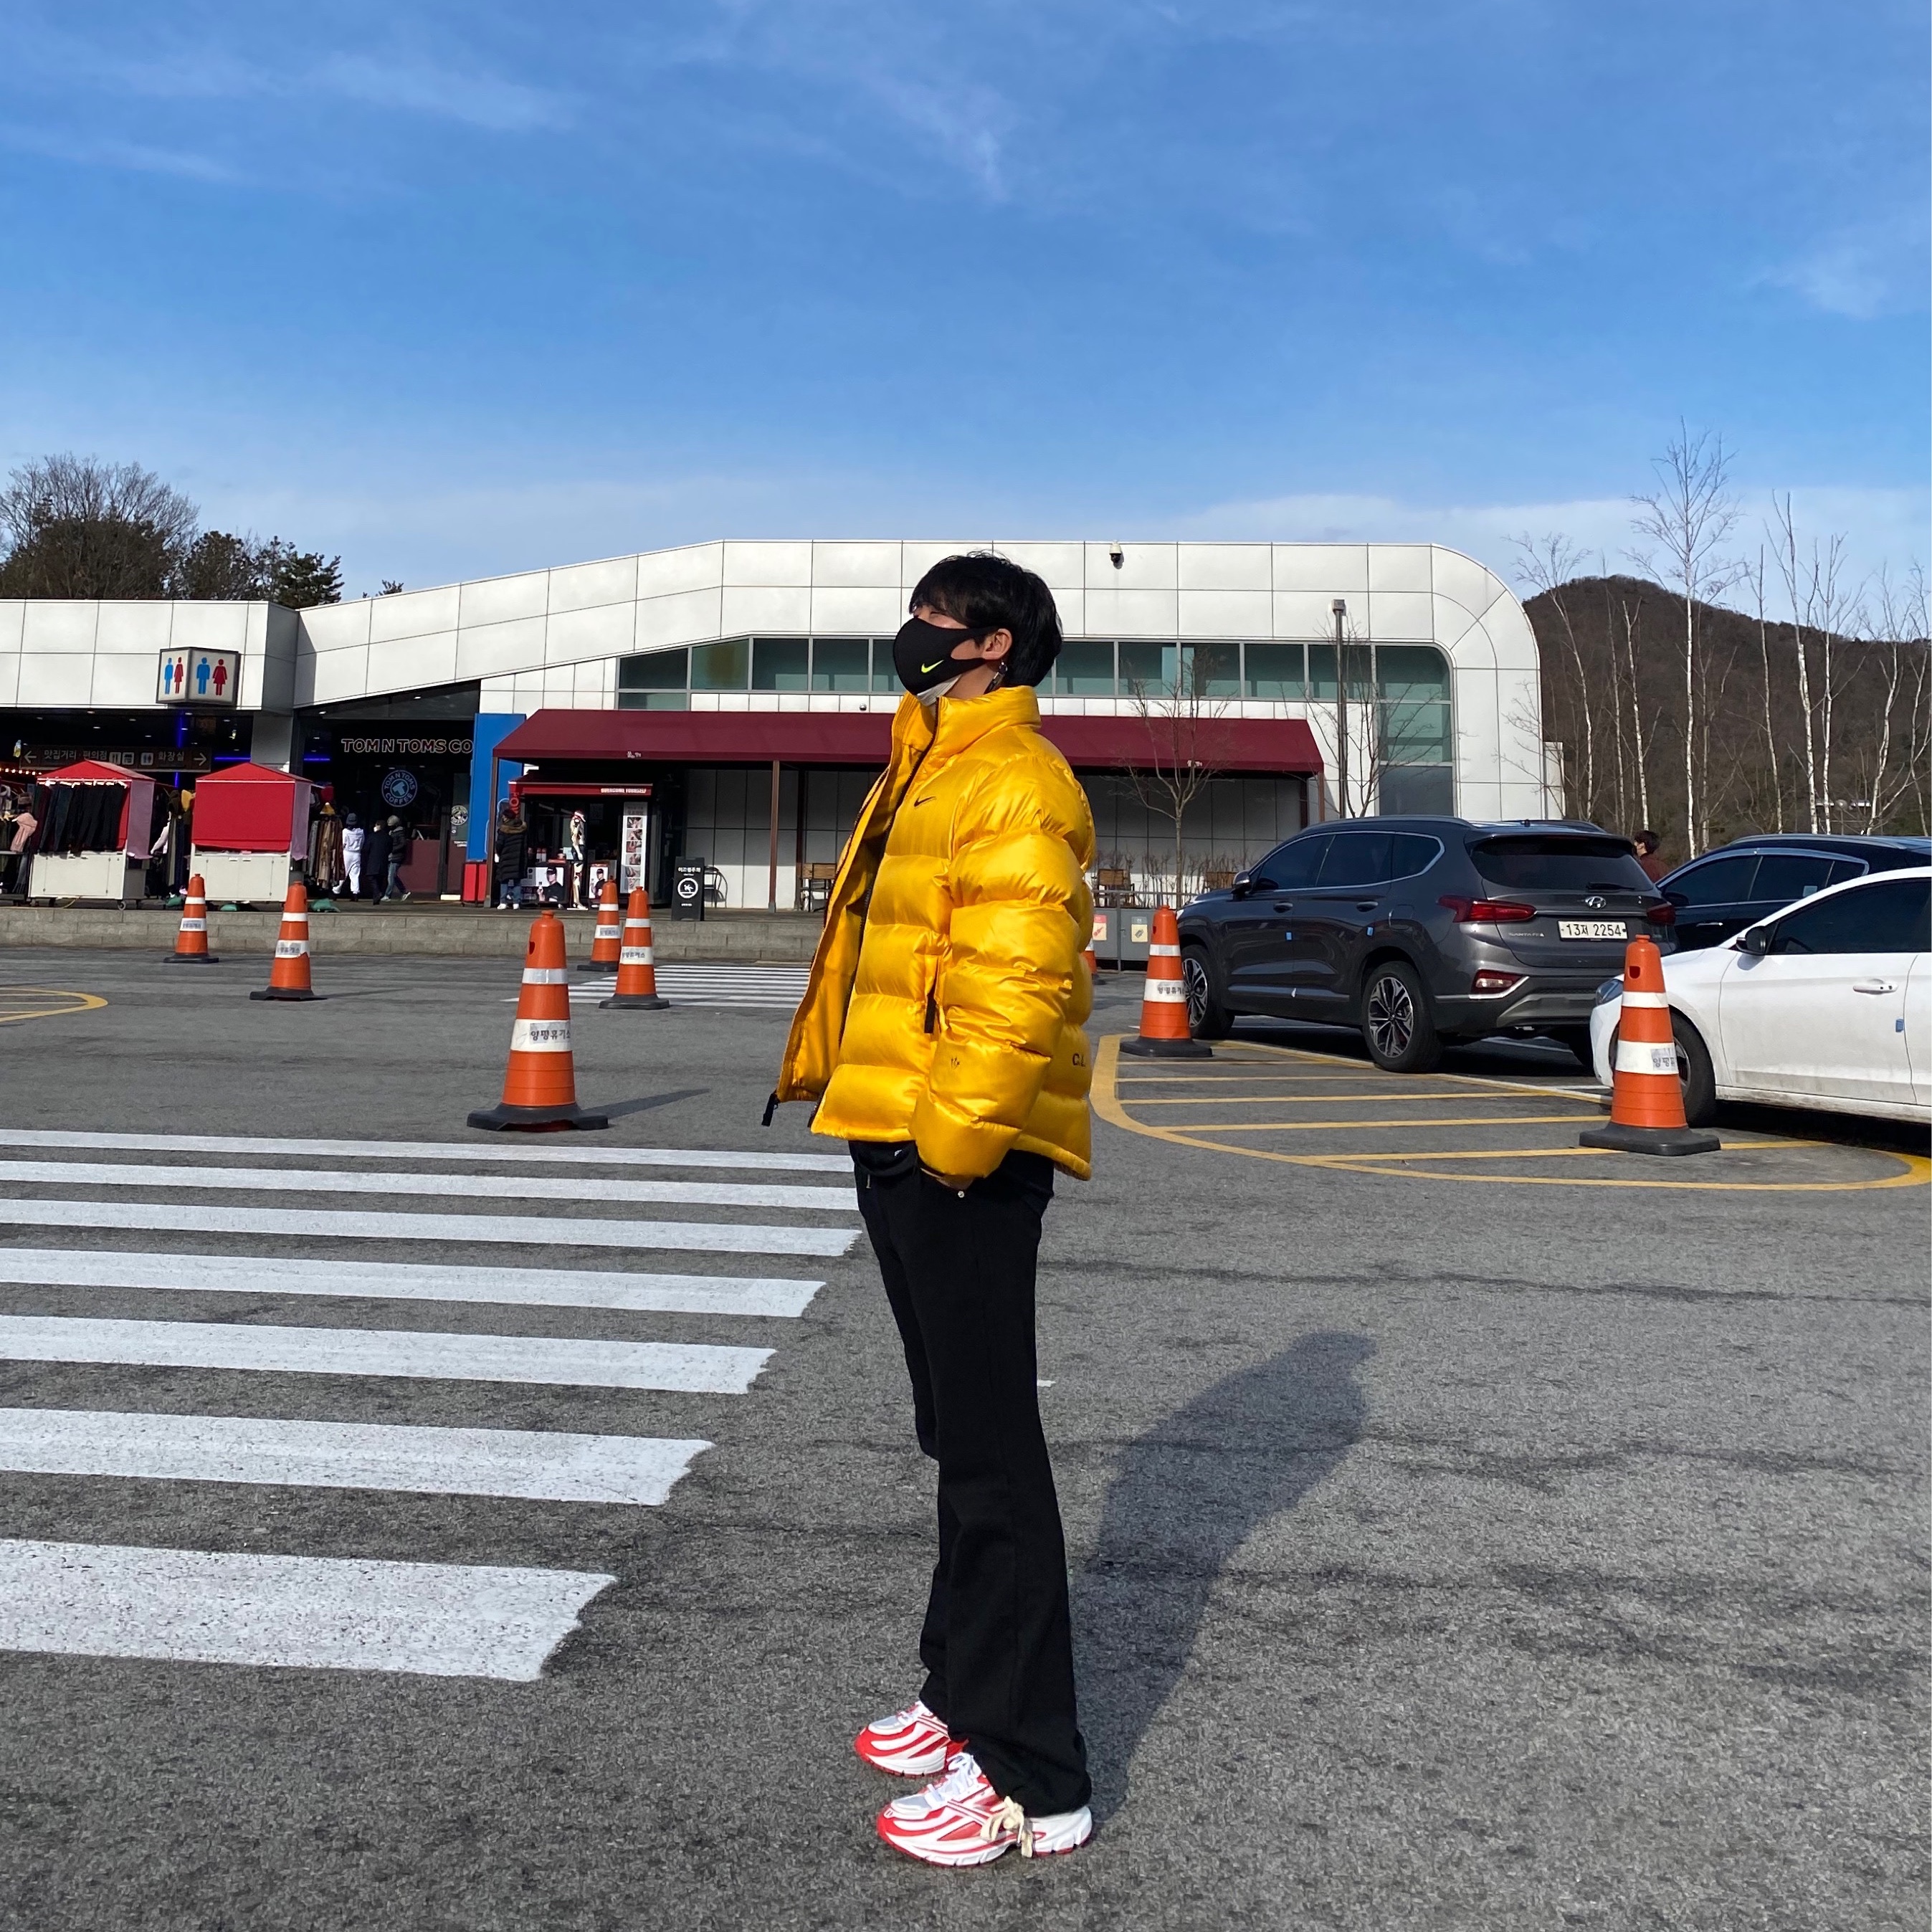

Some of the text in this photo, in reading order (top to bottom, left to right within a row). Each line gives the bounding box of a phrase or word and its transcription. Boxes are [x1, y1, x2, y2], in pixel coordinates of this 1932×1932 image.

[341, 738, 380, 753] TOM
[381, 738, 395, 753] N
[397, 739, 447, 753] TOMS
[44, 749, 77, 760] 맛집거리
[158, 751, 185, 762] 화장실
[384, 775, 395, 790] TOM
[401, 772, 416, 790] TOMS
[385, 792, 413, 804] COFFEE
[1593, 923, 1622, 936] 2254
